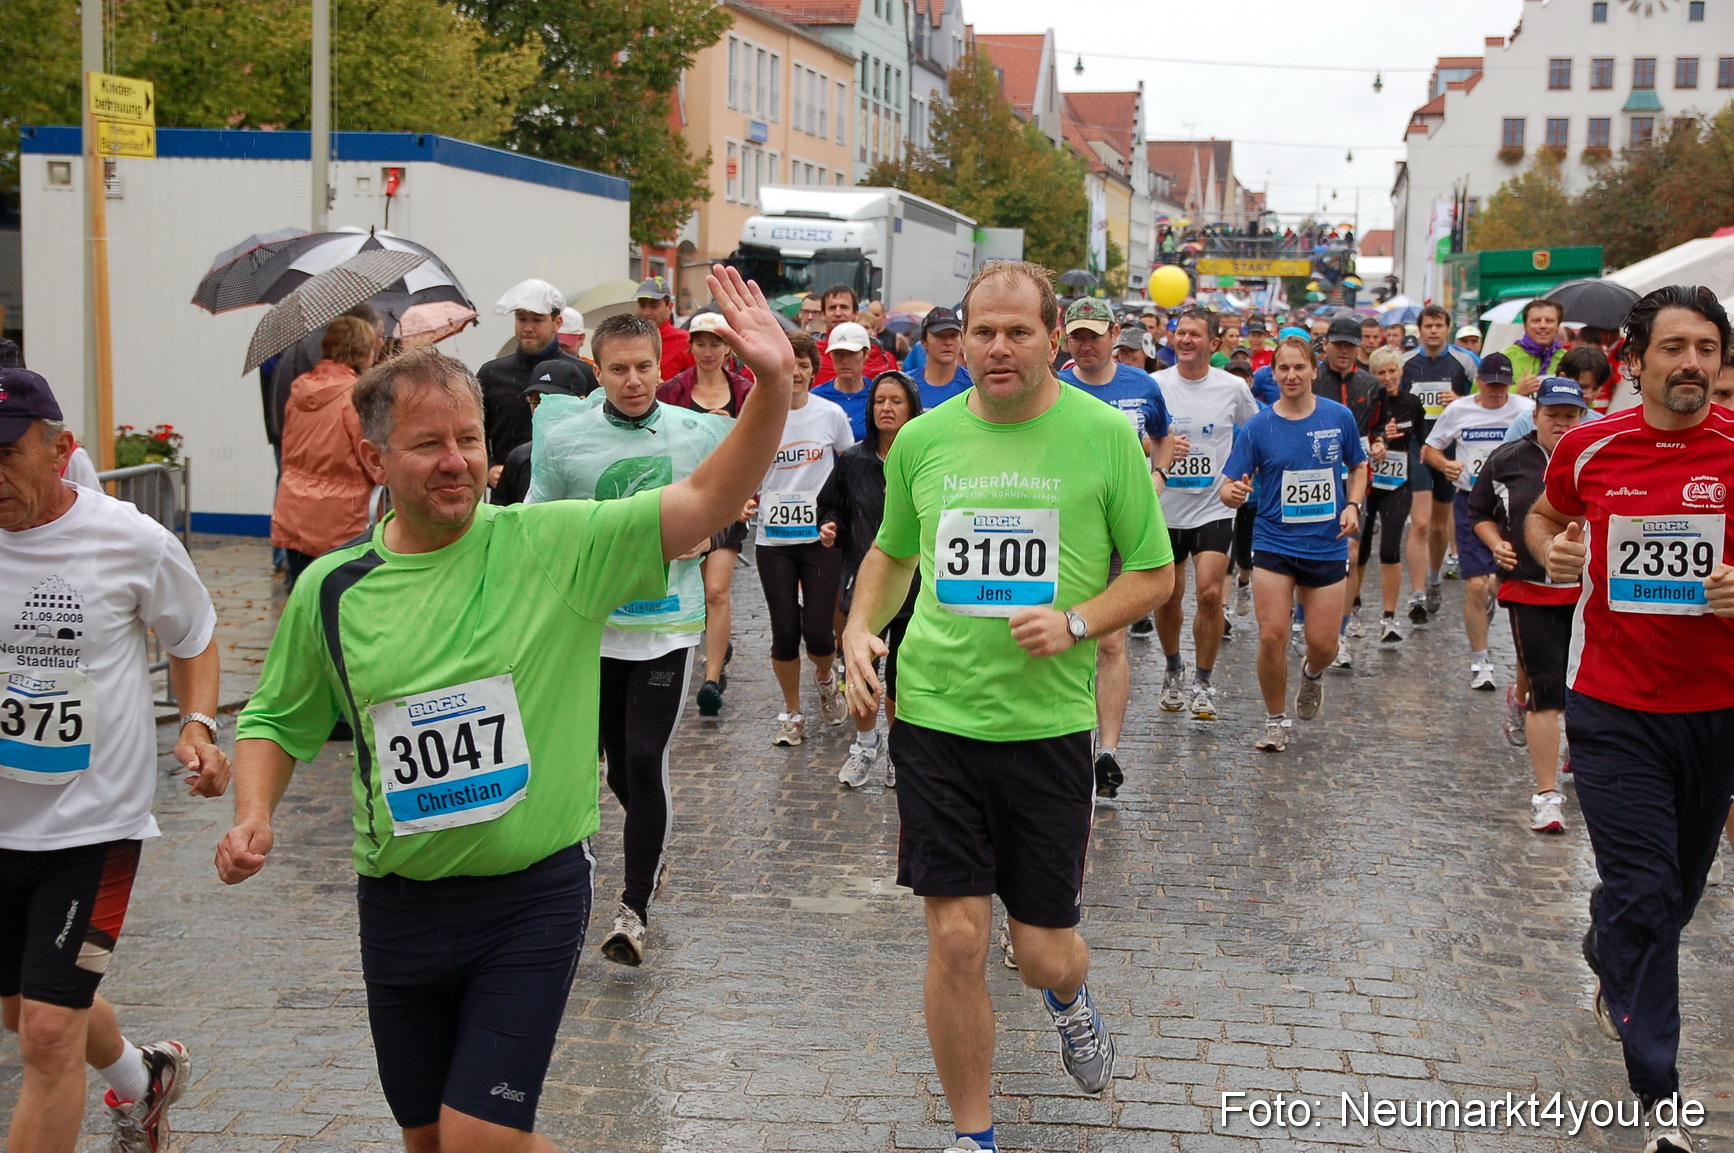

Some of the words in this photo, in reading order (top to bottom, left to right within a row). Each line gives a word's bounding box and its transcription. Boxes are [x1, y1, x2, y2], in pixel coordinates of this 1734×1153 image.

[101, 80, 137, 96] Kinder-
[95, 97, 143, 119] betreuung
[771, 228, 832, 242] BOCK
[1232, 263, 1272, 272] START
[1552, 385, 1579, 395] QUELLE
[1469, 431, 1506, 439] STAEDTL
[1168, 457, 1211, 475] 2388
[1176, 479, 1201, 487] Hubert
[1286, 482, 1331, 504] 2548
[769, 505, 814, 525] 2945
[1295, 507, 1324, 515] Thomas
[974, 516, 1021, 527] BOCK
[1643, 521, 1689, 531] BOCK
[770, 528, 813, 537] Heidemarie
[947, 538, 1046, 577] 3100
[1619, 540, 1714, 578] 2339
[976, 585, 1012, 601] Jens
[1633, 584, 1695, 600] Berthold
[21, 611, 84, 623] 21.09.2008
[0, 643, 81, 656] Neumarkter
[16, 655, 81, 668] Stadtlauf
[8, 673, 56, 691] BOCK
[408, 693, 468, 718] BOCK
[389, 713, 506, 785] 3047
[416, 782, 503, 813] Christian
